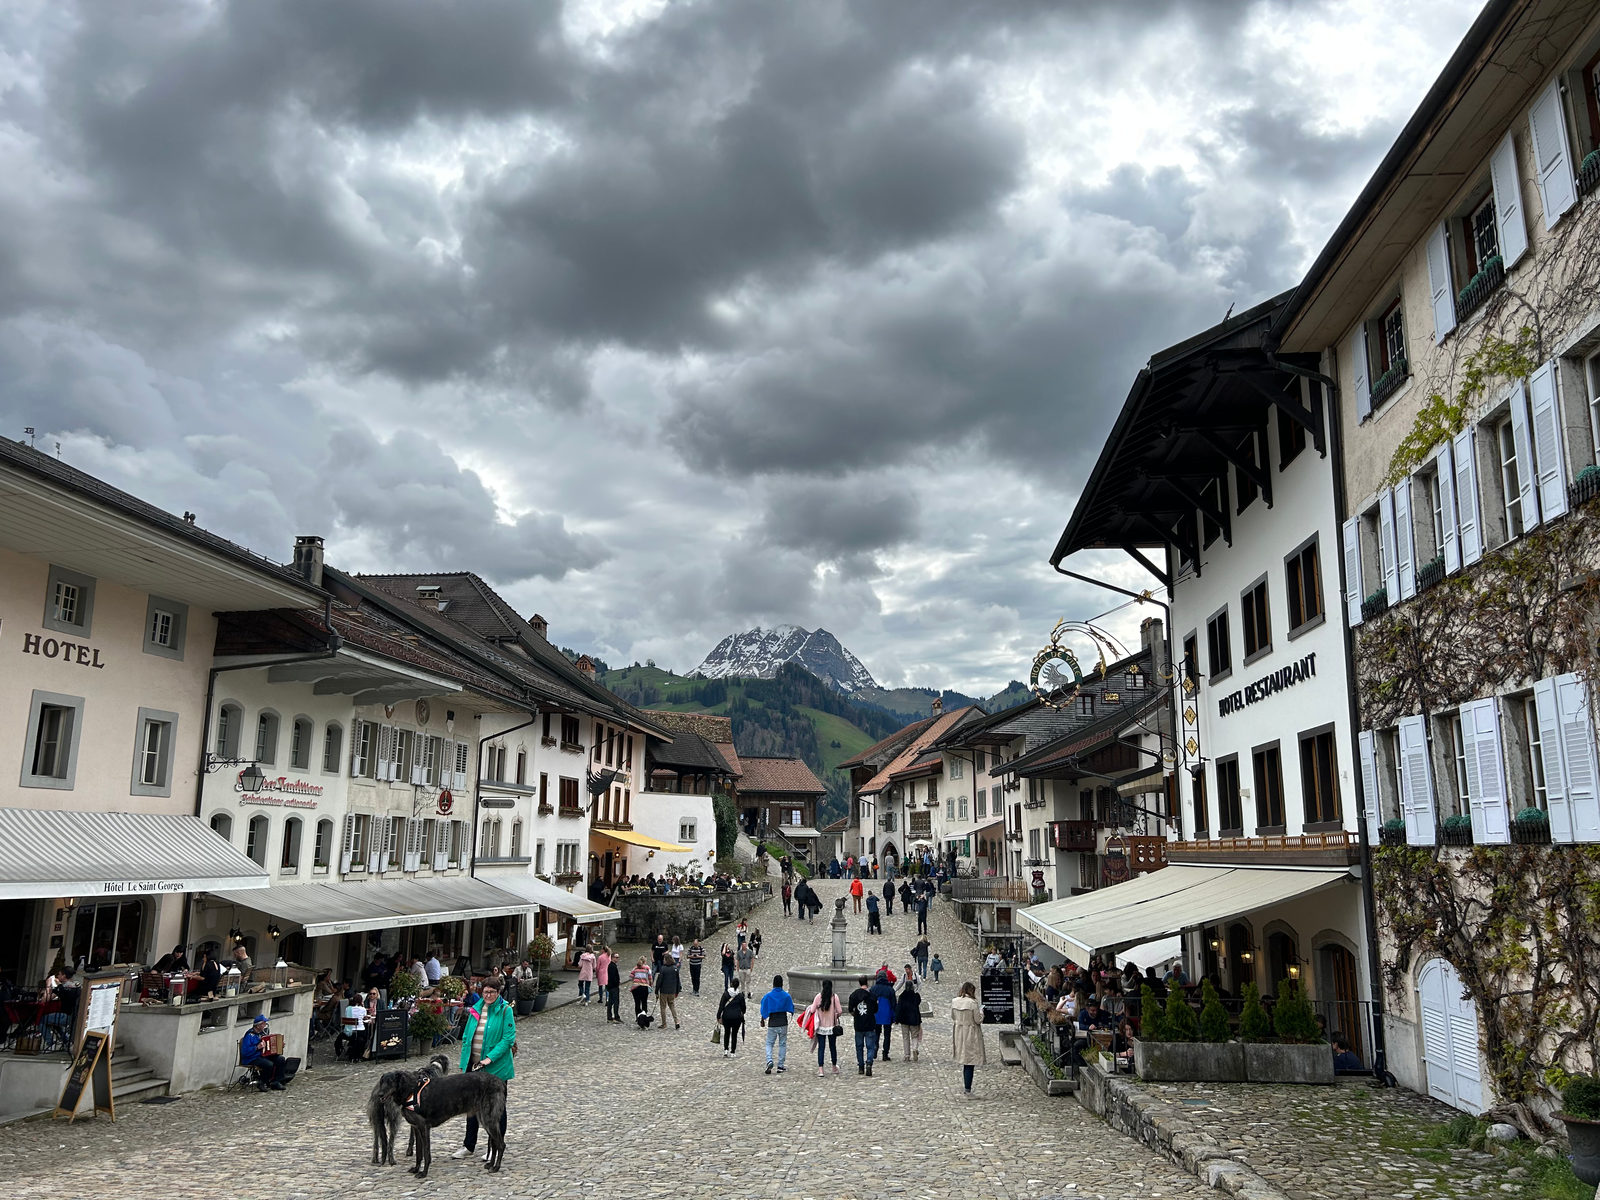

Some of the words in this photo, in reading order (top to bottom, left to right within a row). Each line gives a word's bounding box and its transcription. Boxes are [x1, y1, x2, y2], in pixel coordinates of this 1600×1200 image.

[22, 633, 105, 669] HOTEL
[1031, 654, 1050, 678] HOTEL
[1050, 651, 1063, 659] DE
[1066, 655, 1082, 677] VILLE
[1218, 690, 1245, 718] HOTEL
[1244, 652, 1317, 707] RESTAURANT
[104, 882, 124, 892] Hôtel
[128, 882, 138, 892] Le
[138, 881, 156, 891] Saint
[157, 881, 184, 892] Georges
